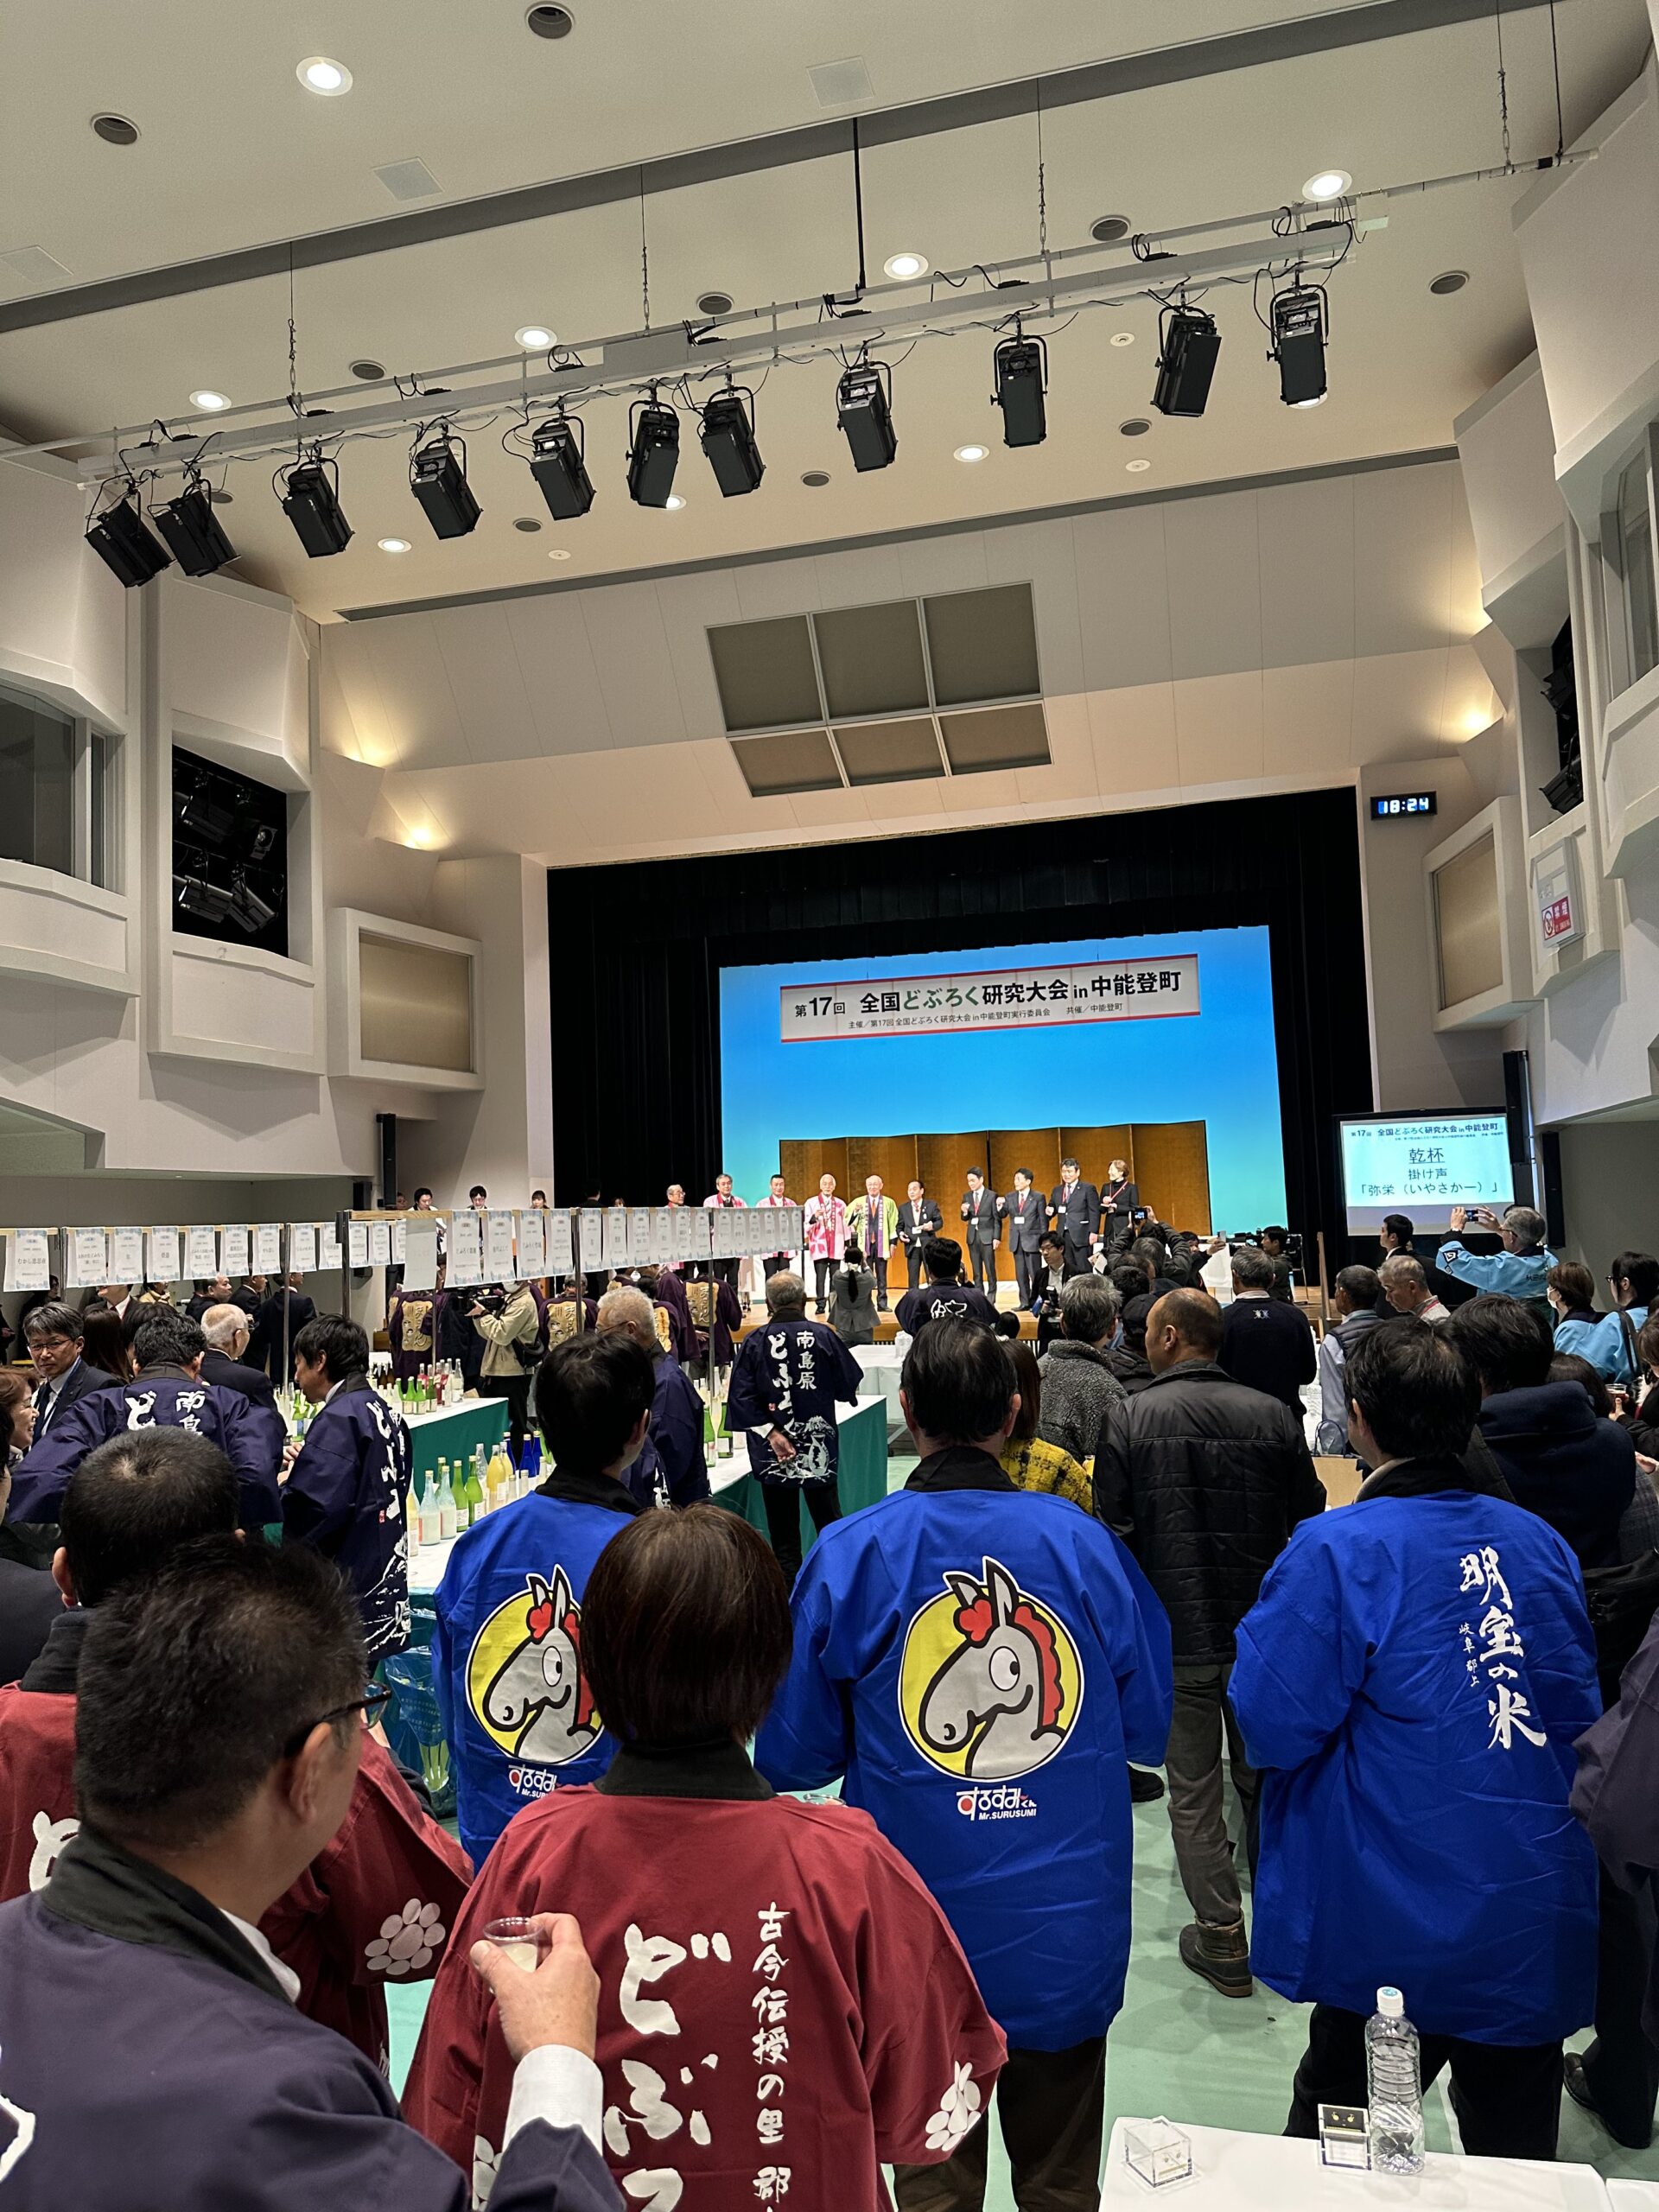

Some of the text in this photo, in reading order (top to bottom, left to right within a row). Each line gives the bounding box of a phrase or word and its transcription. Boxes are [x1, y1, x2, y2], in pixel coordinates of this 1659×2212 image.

[1381, 798, 1430, 815] 18:24
[795, 996, 846, 1018] 第17回
[1408, 1147, 1445, 1163] 乾杯
[1408, 1168, 1448, 1181] 掛け声
[796, 1330, 817, 1390] 南島原
[1459, 1545, 1548, 1751] 明宝の米
[978, 1808, 1038, 1821] Mr.SURUSUMI
